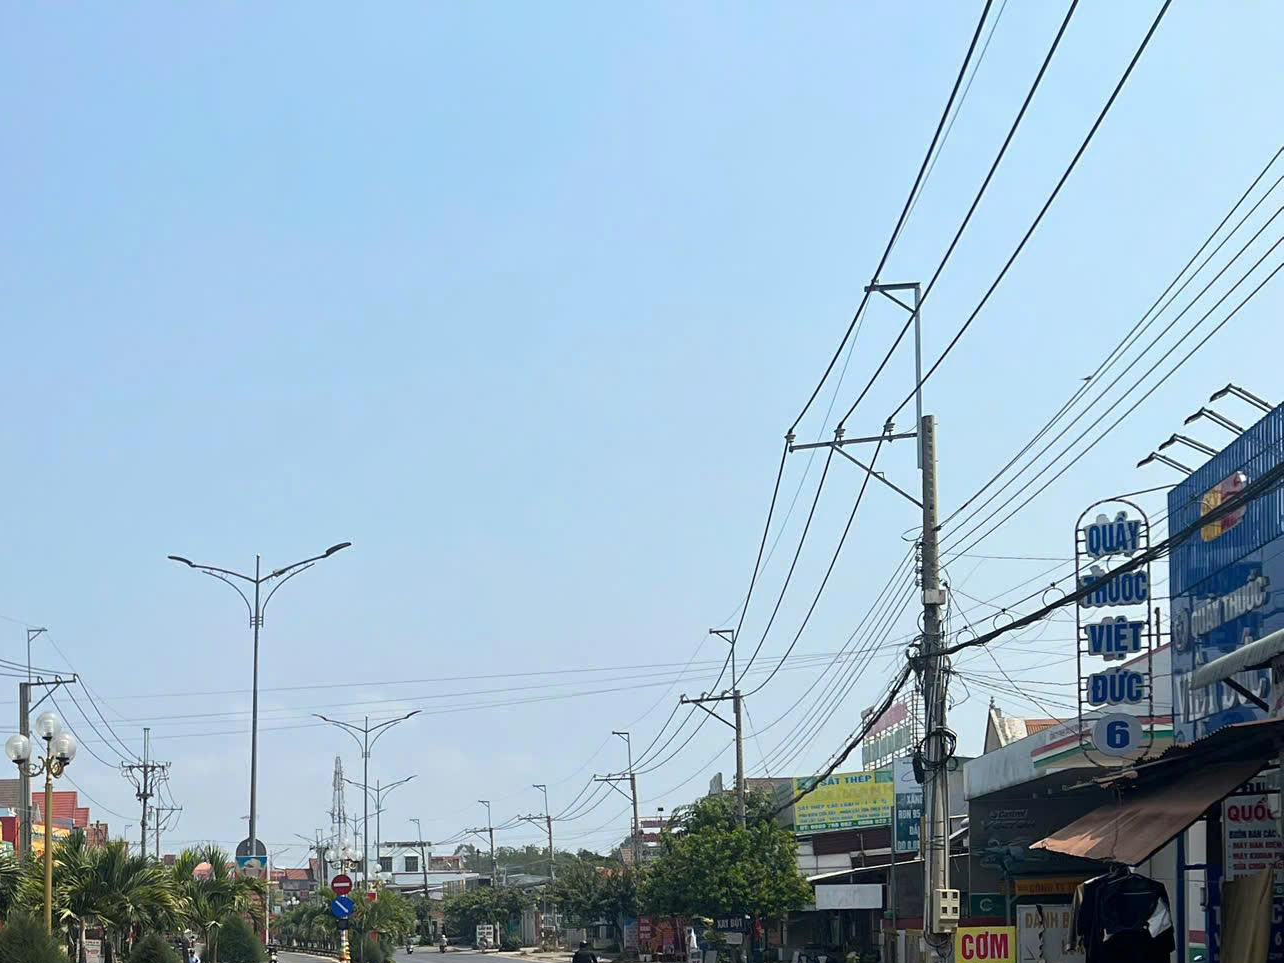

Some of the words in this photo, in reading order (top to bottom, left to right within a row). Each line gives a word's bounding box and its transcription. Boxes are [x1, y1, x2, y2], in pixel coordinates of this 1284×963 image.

[1089, 616, 1143, 659] VIỆT
[1091, 667, 1143, 703] ĐỨC
[1106, 720, 1130, 749] 6
[961, 931, 1009, 960] CƠM
